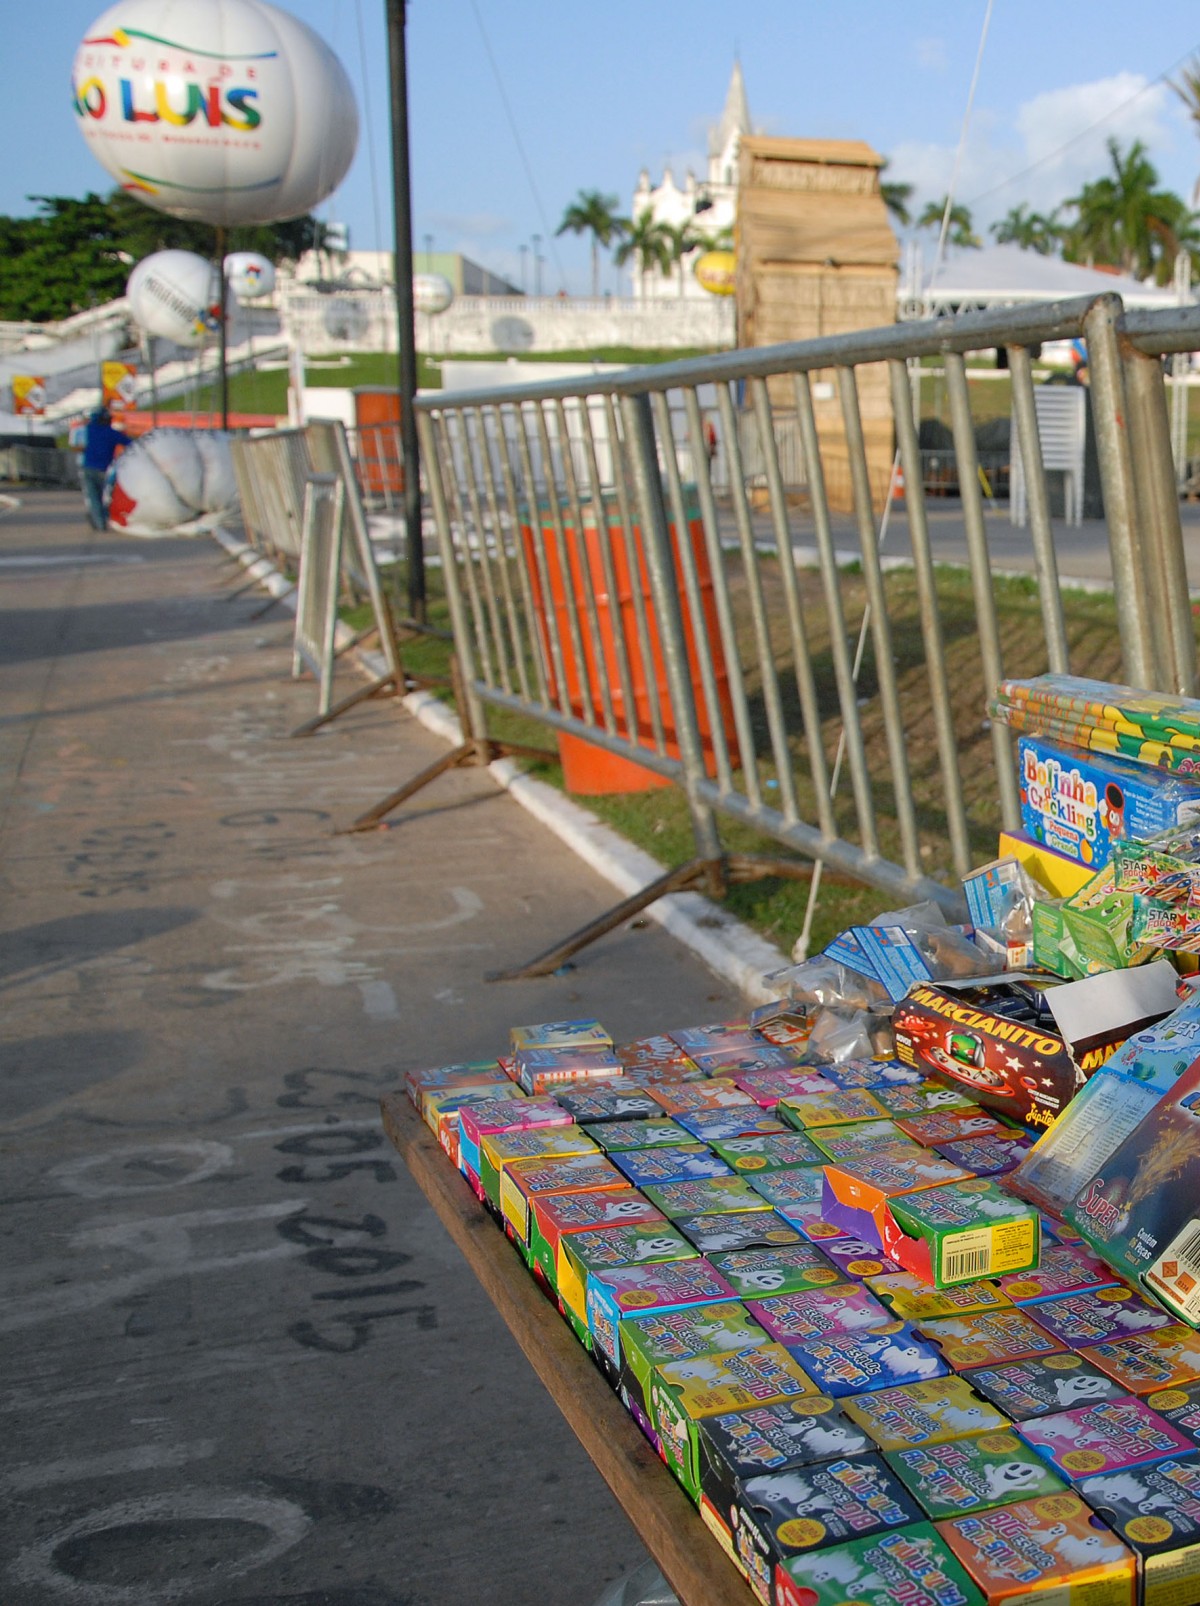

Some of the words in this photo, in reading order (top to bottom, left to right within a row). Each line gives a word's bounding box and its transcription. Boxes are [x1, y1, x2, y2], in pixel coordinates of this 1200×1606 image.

[1025, 748, 1098, 810] Bolinha
[1029, 781, 1096, 839] Crackling
[1047, 817, 1080, 843] Pequena
[1051, 833, 1079, 858] Grande
[1123, 858, 1148, 872] STAR
[1147, 908, 1178, 924] STAR
[1147, 918, 1178, 931] FOGOS
[909, 988, 1063, 1056] MARCIANITO
[1135, 1242, 1153, 1261] Peças
[1136, 1226, 1158, 1249] Contém
[276, 1206, 438, 1353] 2015
[630, 1313, 696, 1361] FANTASMINHA
[660, 1311, 688, 1336] BIG
[734, 1344, 806, 1397] FANTASMINHA
[800, 1343, 872, 1388] FANTASMINHA
[829, 1337, 856, 1360] BIG
[845, 1352, 882, 1377] ESTALOS
[746, 1374, 780, 1402] BIG
[997, 1365, 1029, 1386] BIG
[1018, 1380, 1059, 1405] ESTALOS
[742, 1408, 775, 1438] BIG
[762, 1425, 802, 1456] ESTALOS
[852, 1394, 931, 1445] FANTASMINHA
[876, 1388, 918, 1412] BIG
[898, 1403, 943, 1433] ESTALOS
[1092, 1401, 1177, 1453] FANTASMINHA
[713, 1412, 789, 1468] FANTASMINHA
[1115, 1433, 1153, 1459] BIG
[812, 1471, 843, 1499] ESTALOS
[826, 1458, 908, 1526] FANTASMINHA
[898, 1447, 981, 1509] FANTASMINHA
[926, 1442, 960, 1469] BIG
[951, 1461, 994, 1497] ESTALOS
[1144, 1471, 1190, 1505] ESTALOS
[833, 1497, 880, 1531] BIG
[952, 1515, 1043, 1584] FANTASMINHA
[981, 1509, 1017, 1539] BIG
[1009, 1533, 1058, 1570] ESTALOS
[863, 1547, 901, 1580] ESTALOS
